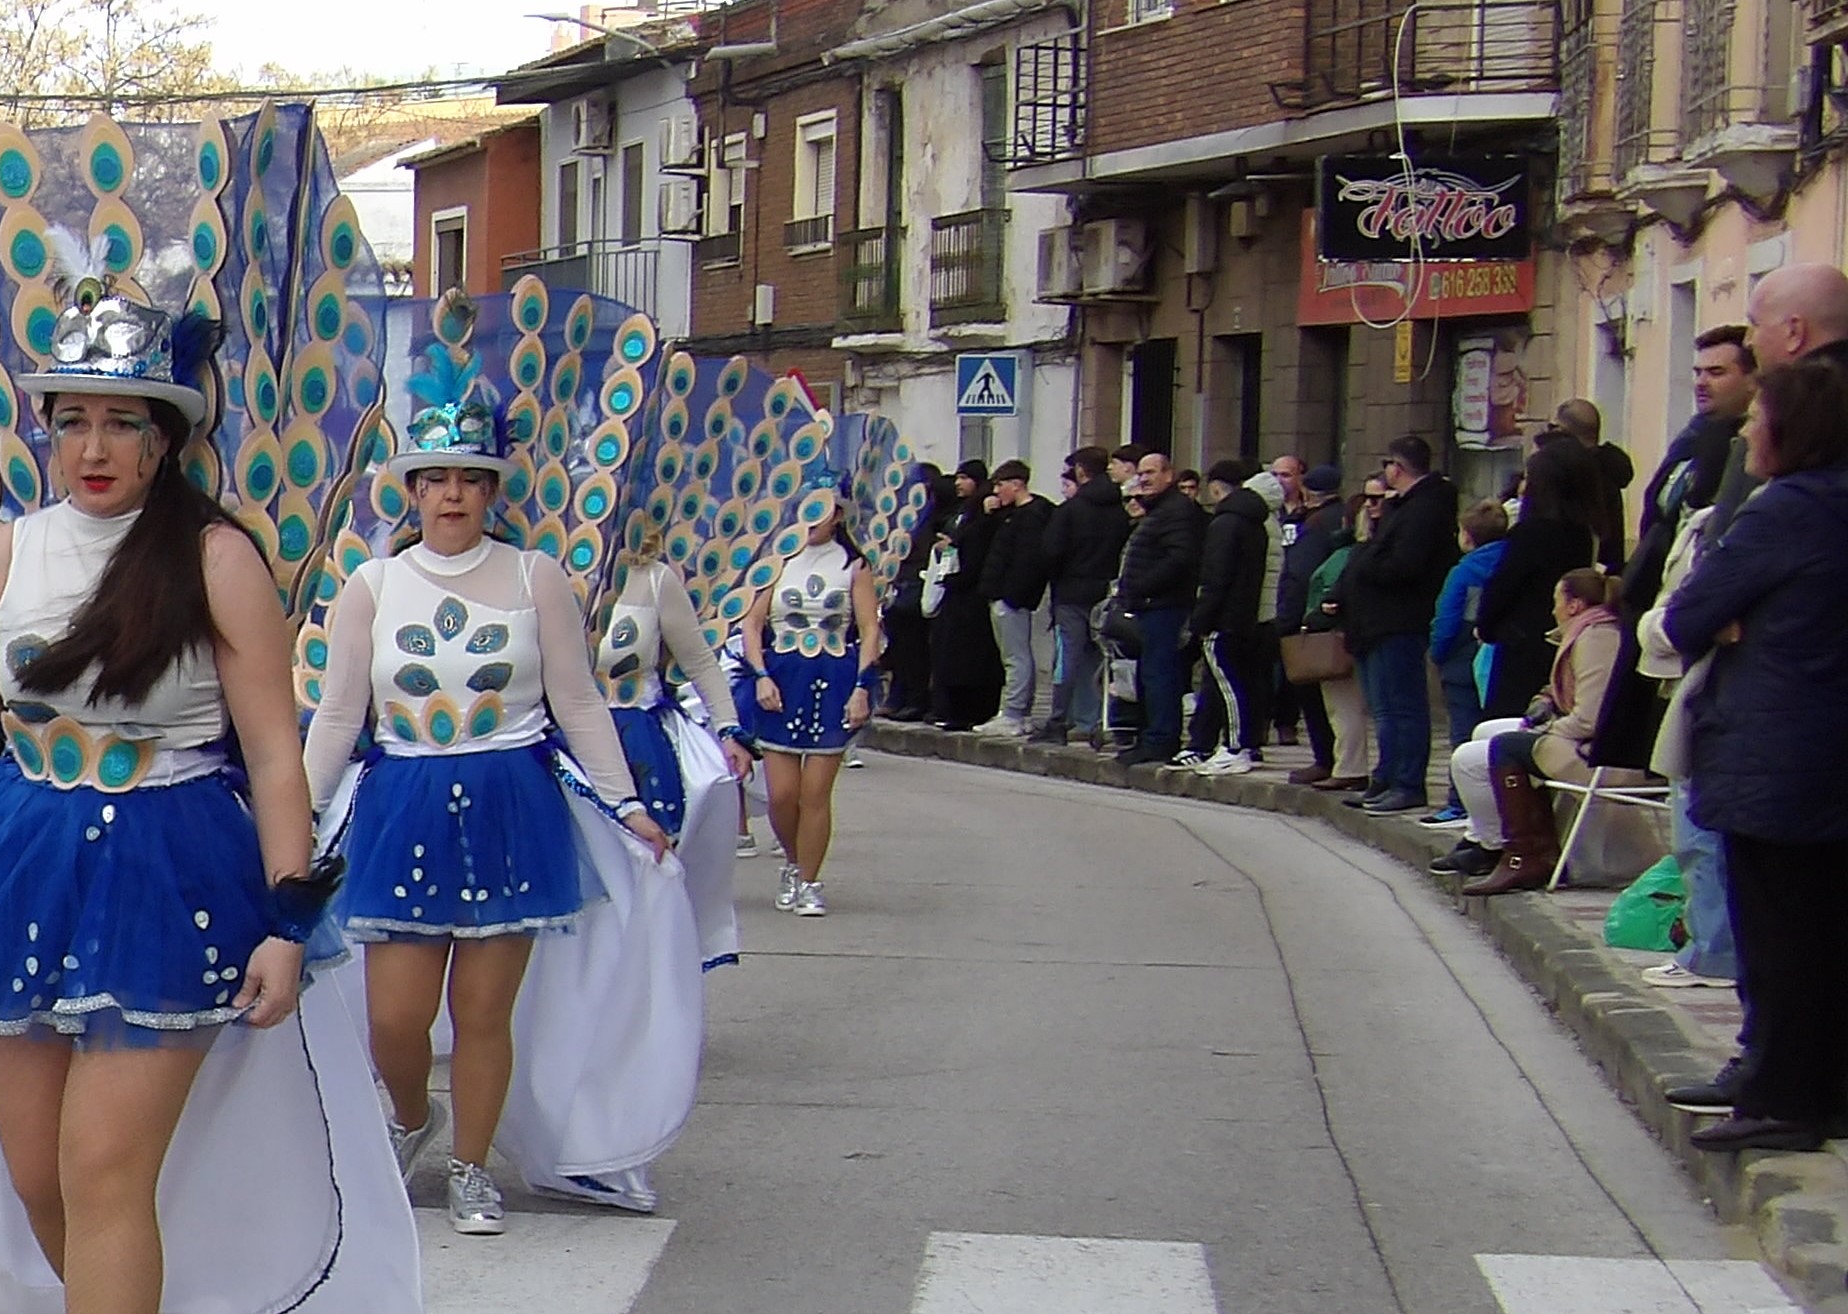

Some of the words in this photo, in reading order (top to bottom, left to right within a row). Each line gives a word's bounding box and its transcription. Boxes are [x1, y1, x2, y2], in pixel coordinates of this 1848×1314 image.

[1337, 179, 1516, 241] Tattoo
[1442, 269, 1465, 299] 616
[1465, 267, 1490, 297] 258
